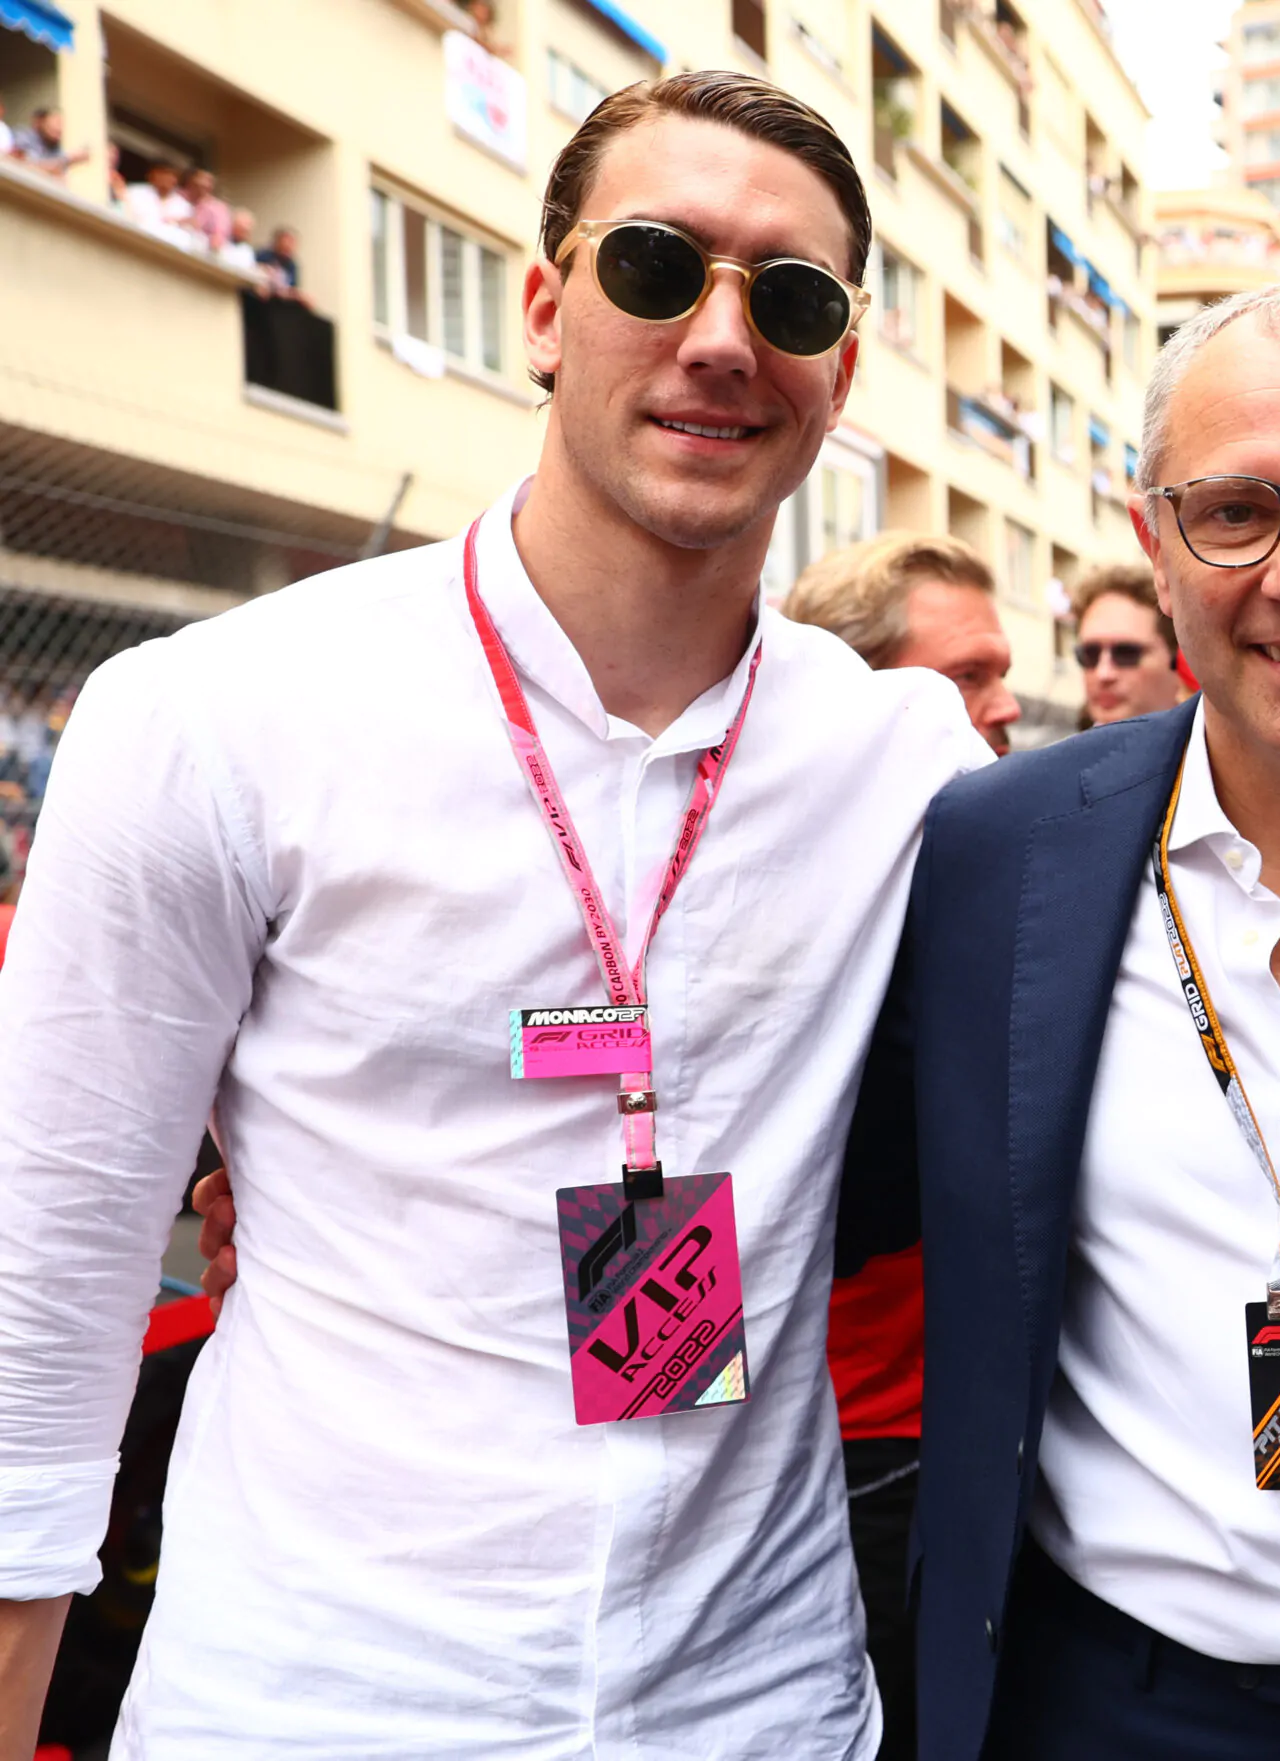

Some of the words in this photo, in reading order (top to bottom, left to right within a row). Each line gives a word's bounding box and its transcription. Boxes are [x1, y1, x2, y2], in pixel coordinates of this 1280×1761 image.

[526, 755, 548, 794] 2022
[543, 797, 567, 837] VIP
[679, 808, 699, 851] 2022
[581, 888, 600, 919] 2030
[1159, 892, 1178, 942] 2022
[593, 923, 606, 939] BY
[600, 942, 624, 992] CARBON
[1185, 982, 1208, 1032] GRID
[577, 1028, 649, 1041] GRID
[587, 1225, 713, 1374] VIP
[621, 1266, 717, 1383] ACCESS
[651, 1319, 716, 1399] 2022
